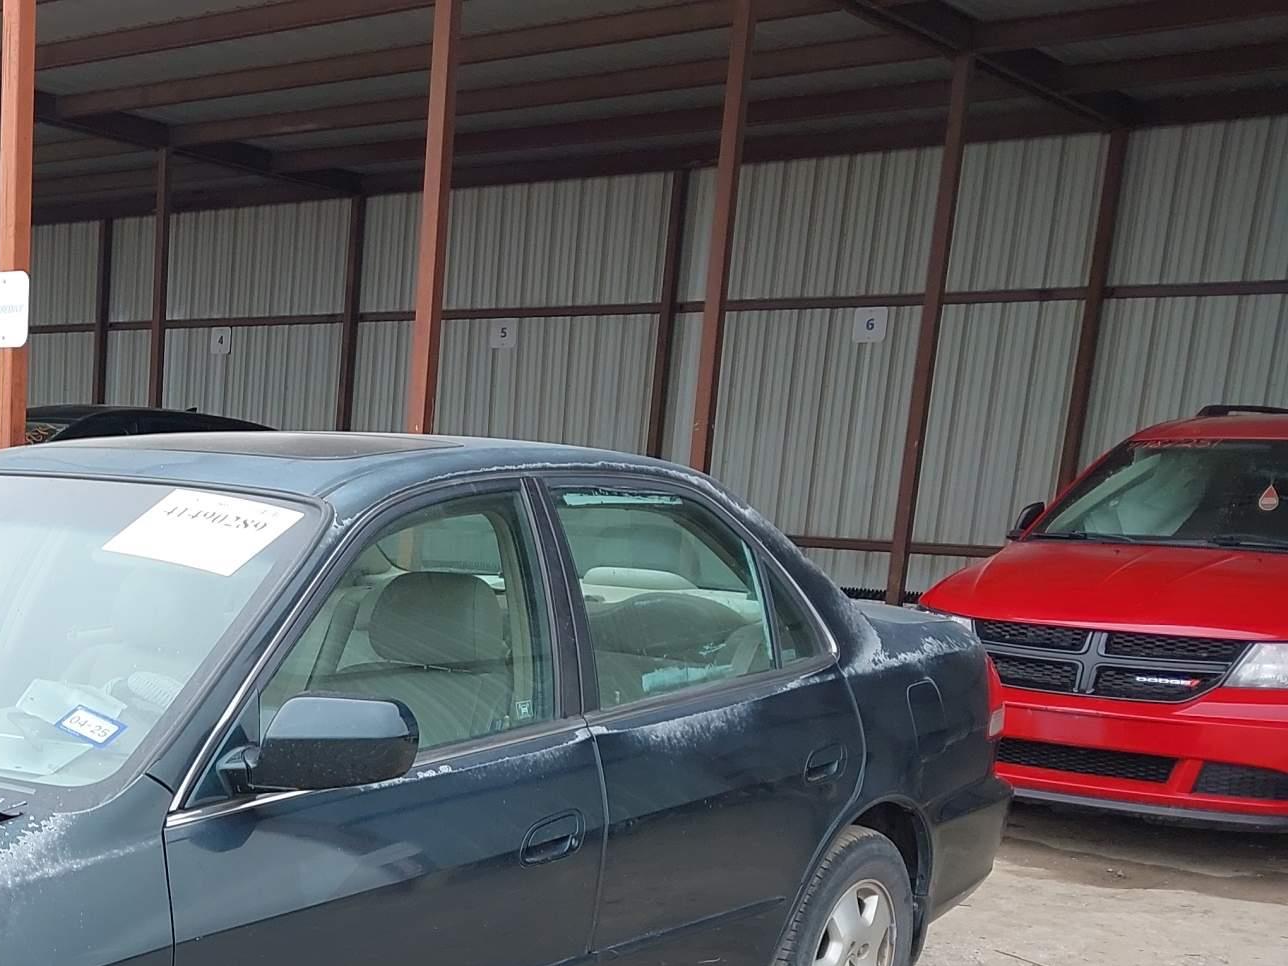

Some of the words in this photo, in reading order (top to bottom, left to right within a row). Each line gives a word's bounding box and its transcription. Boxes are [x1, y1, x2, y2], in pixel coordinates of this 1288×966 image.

[866, 318, 875, 331] 6
[500, 327, 508, 338] 5
[217, 335, 224, 345] 4
[163, 505, 268, 532] 41490289
[1135, 676, 1192, 686] DODGE
